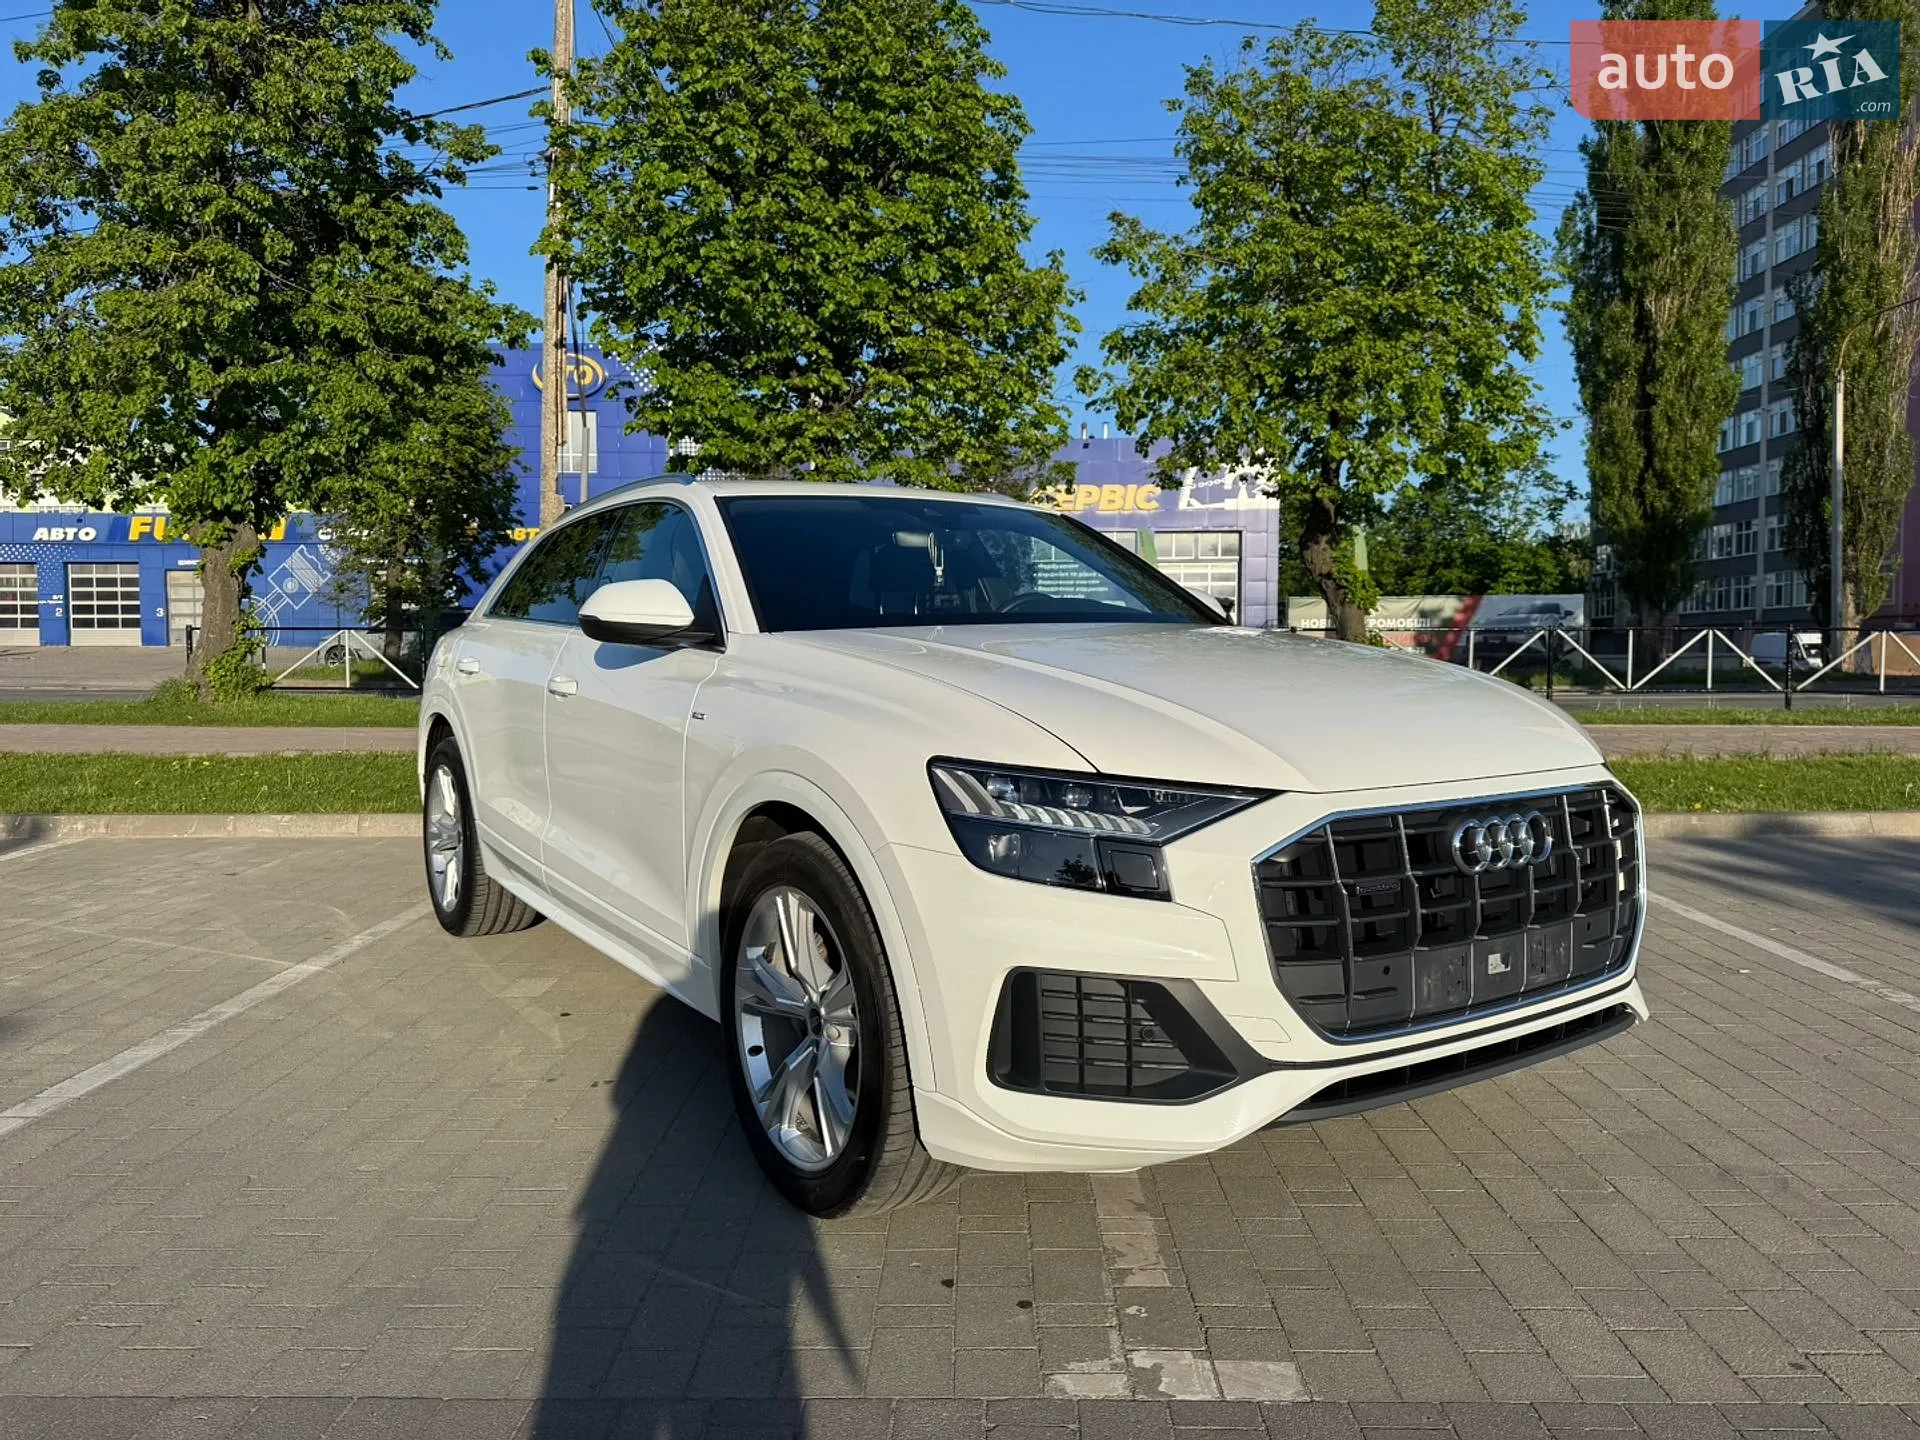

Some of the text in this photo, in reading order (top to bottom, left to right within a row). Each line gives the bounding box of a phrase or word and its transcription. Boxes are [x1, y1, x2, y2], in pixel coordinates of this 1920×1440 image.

[33, 527, 97, 542] АВТО
[156, 608, 164, 617] 3
[1366, 618, 1430, 628] РОМОБІЛІ
